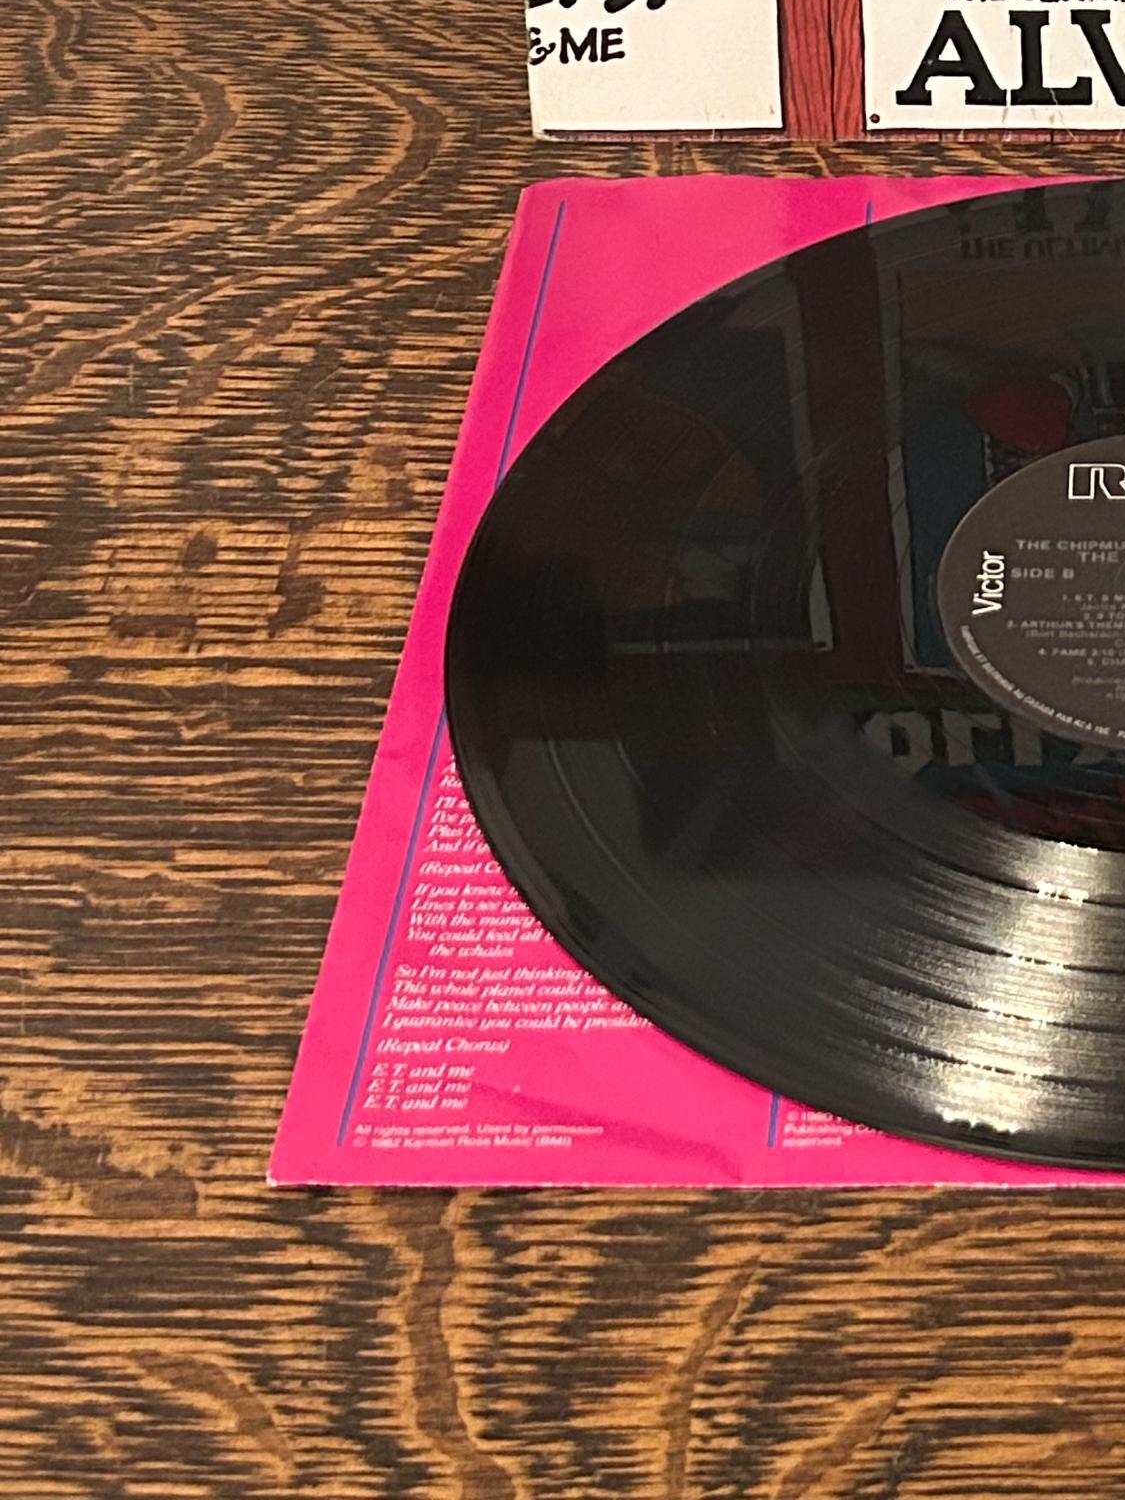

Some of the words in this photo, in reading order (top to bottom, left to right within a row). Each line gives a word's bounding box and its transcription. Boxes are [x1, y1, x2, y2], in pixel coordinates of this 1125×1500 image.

[559, 26, 626, 64] ME
[1016, 539, 1051, 551] THE
[1079, 550, 1119, 563] THE
[1010, 567, 1055, 579] SIDE
[971, 550, 1006, 617] Victor
[512, 966, 583, 982] thinking
[514, 1014, 563, 1029] could
[375, 1037, 444, 1056] (Repeat
[443, 1036, 513, 1055] Chorus)
[408, 1062, 448, 1078] and
[446, 1064, 477, 1078] me
[404, 1078, 444, 1094] and
[443, 1081, 473, 1094] me
[400, 1094, 440, 1110] and
[439, 1097, 469, 1110] me
